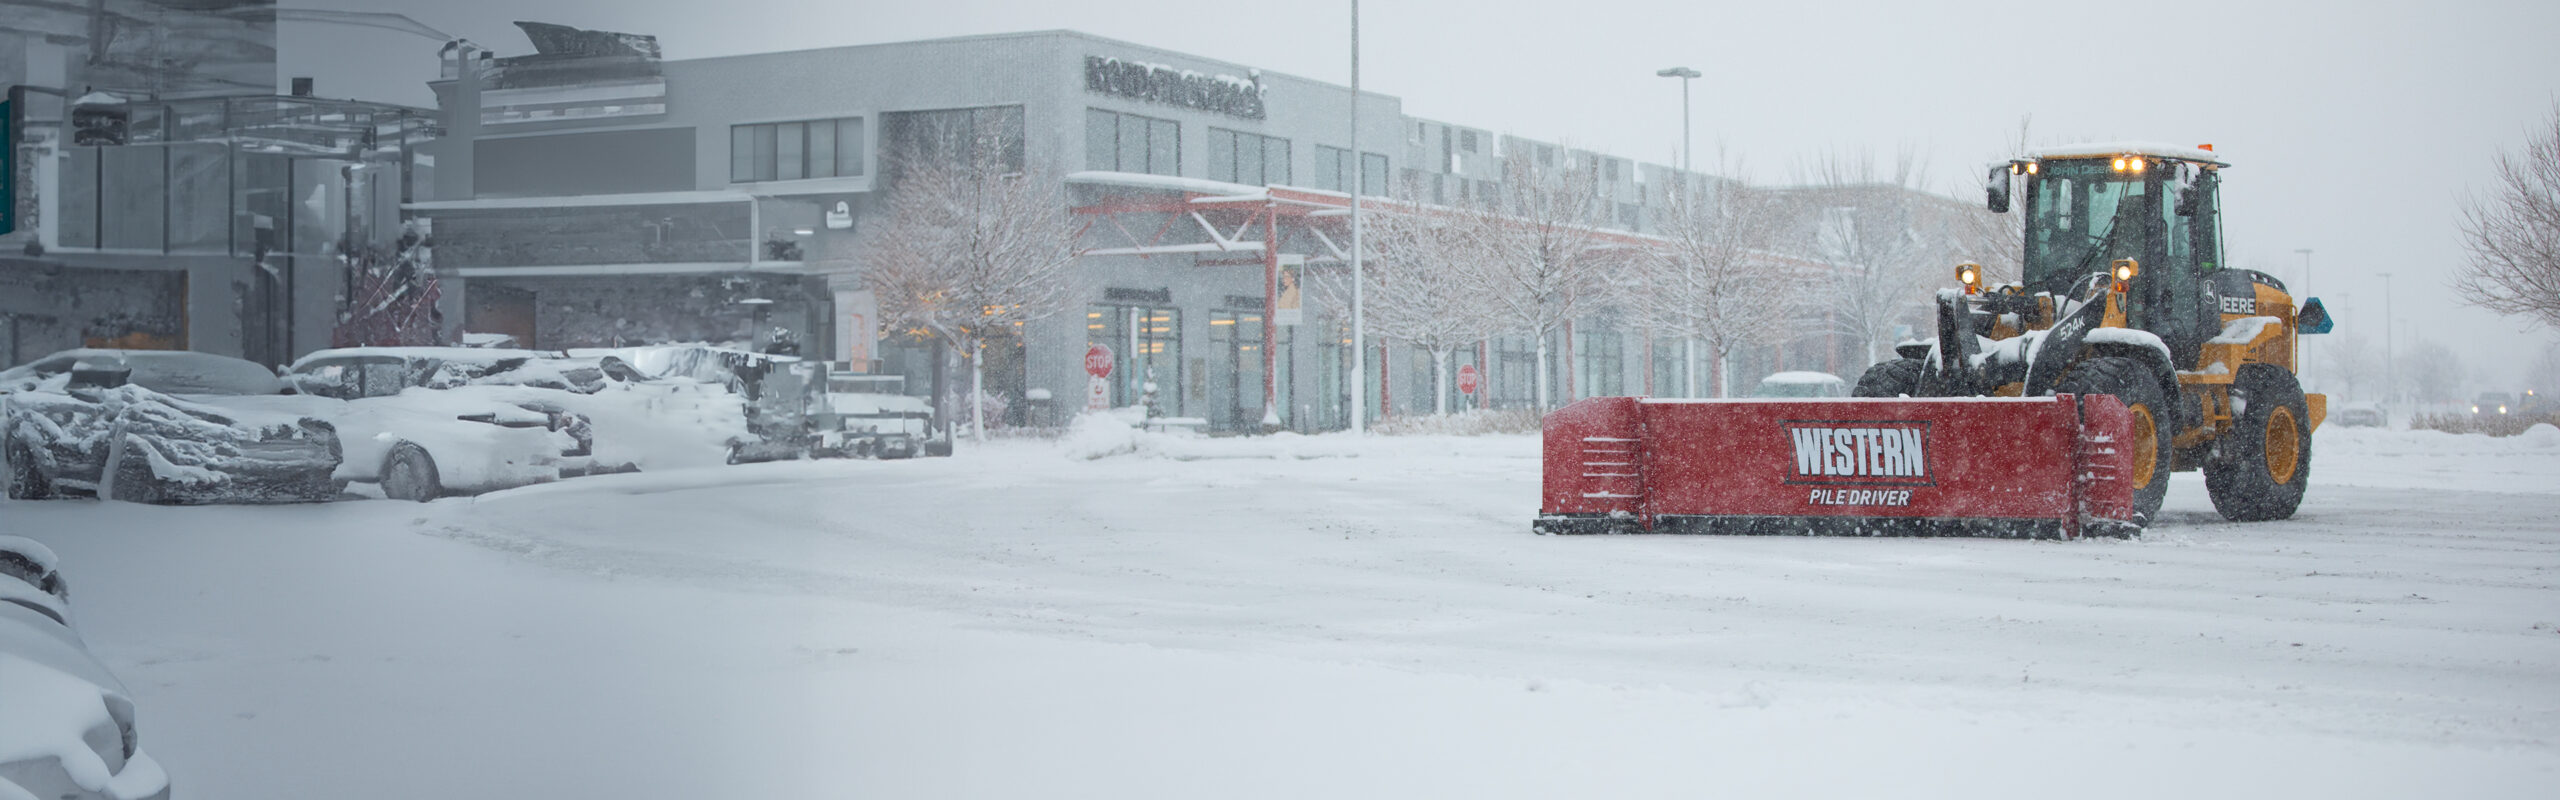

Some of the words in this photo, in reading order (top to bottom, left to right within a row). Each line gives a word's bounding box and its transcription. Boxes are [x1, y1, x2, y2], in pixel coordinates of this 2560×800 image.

[2046, 166, 2079, 176] JOHN
[2060, 315, 2086, 341] 524K
[1087, 354, 1112, 369] STOP
[1459, 373, 1477, 385] STOP
[1791, 428, 1924, 476] WESTERN
[1809, 489, 1847, 505] PILE
